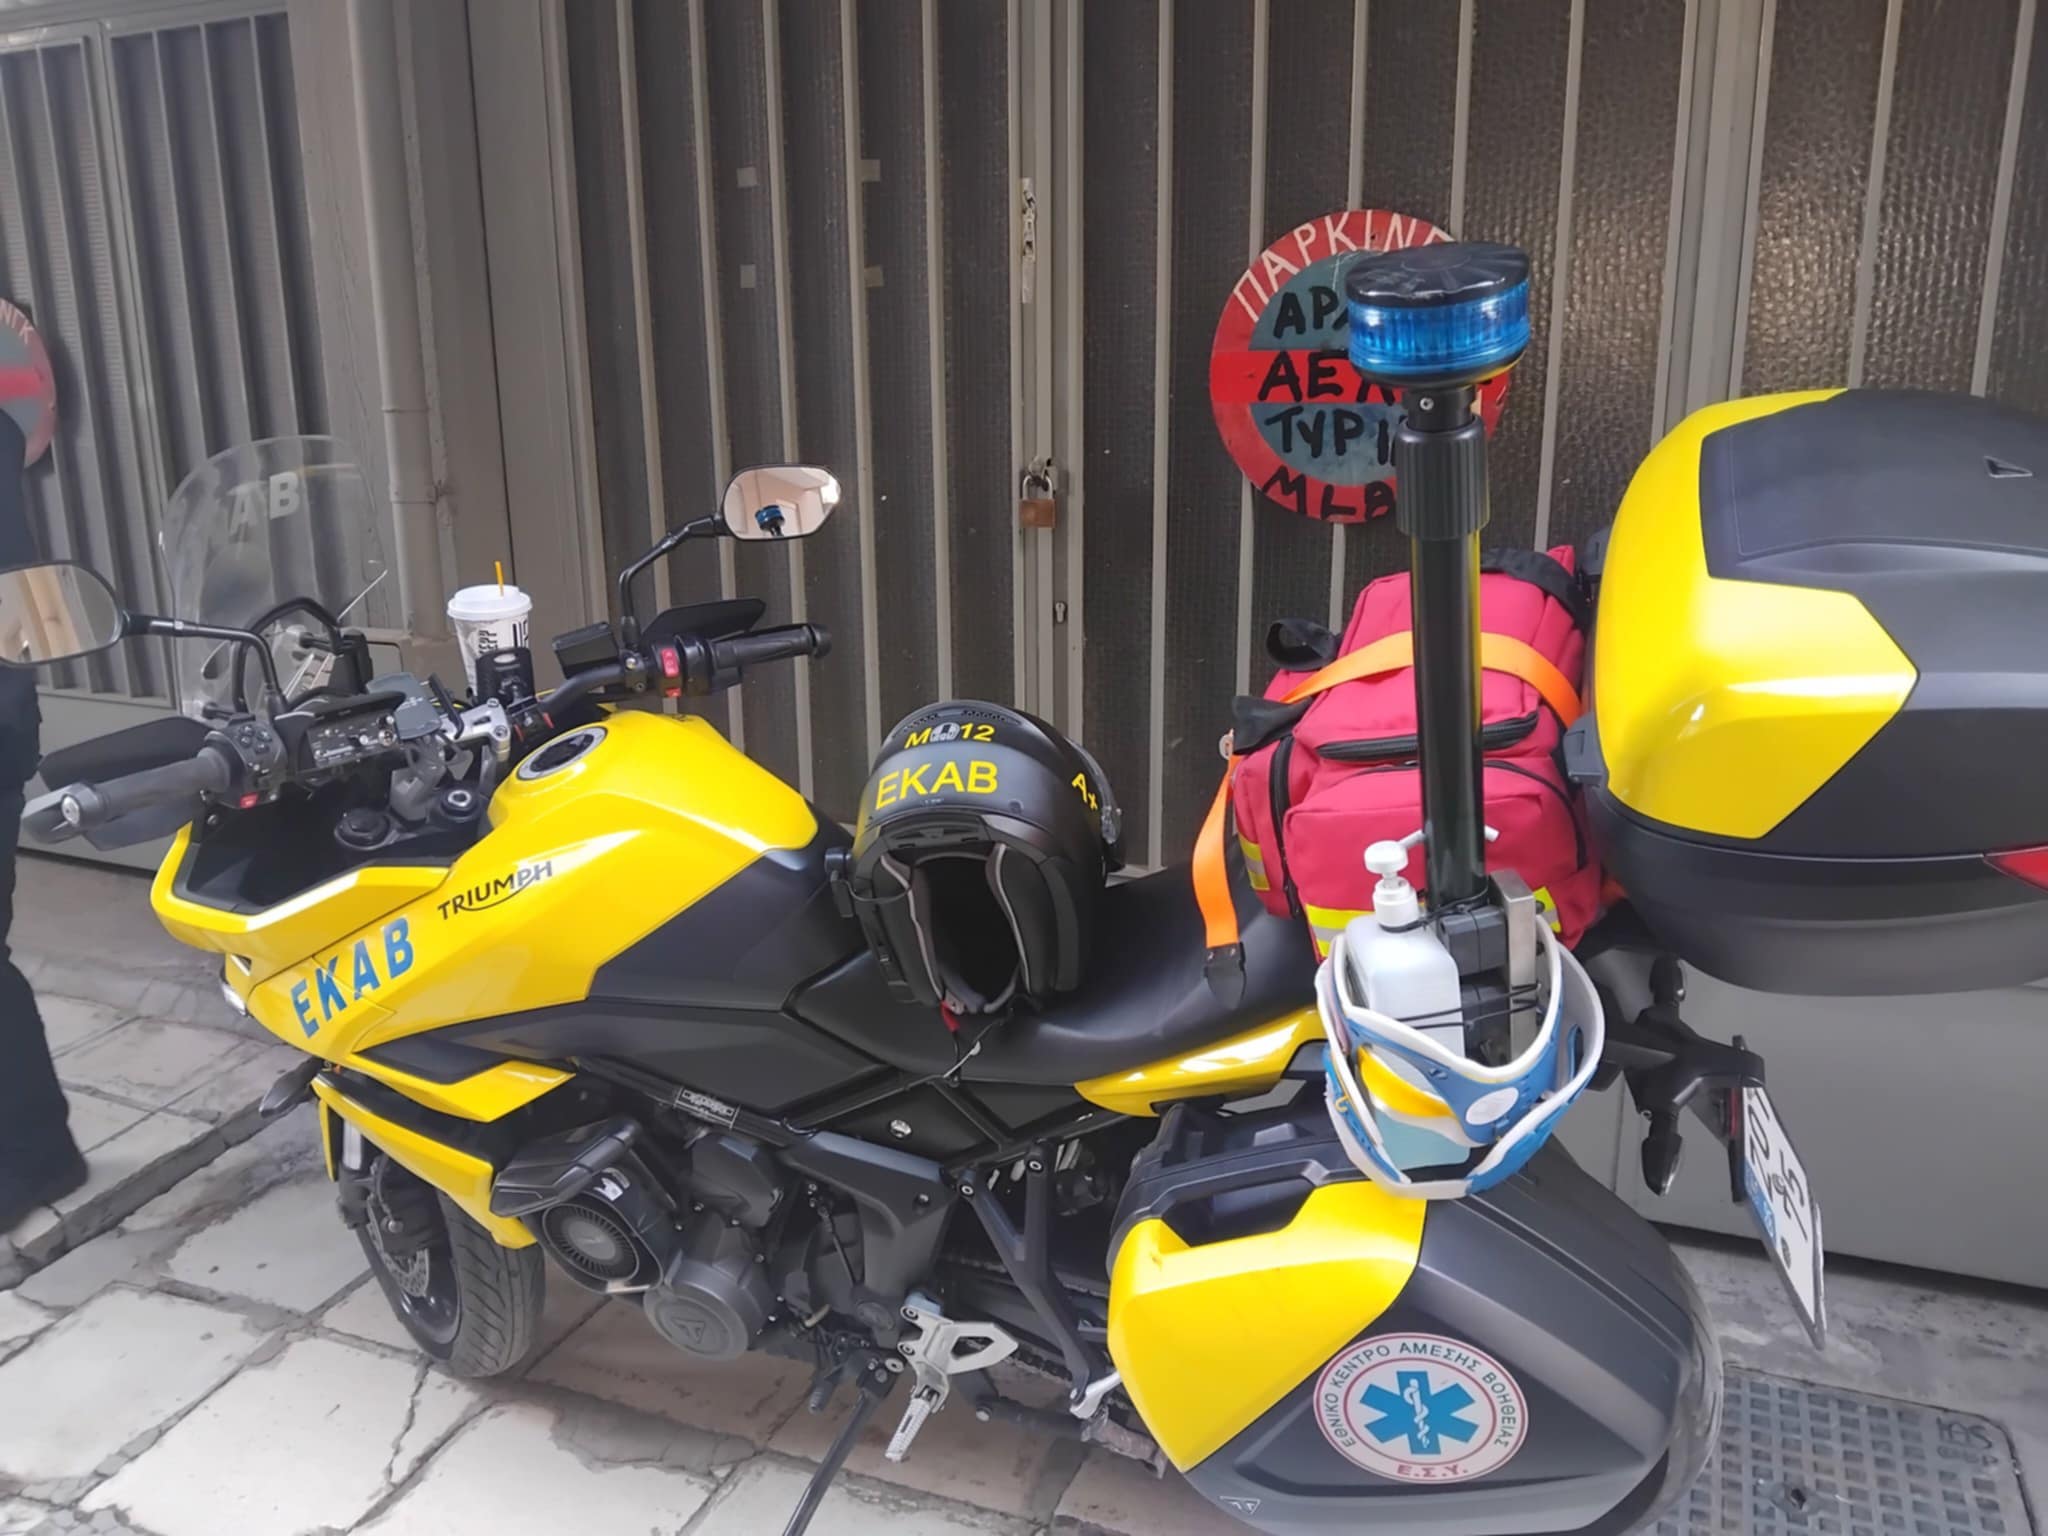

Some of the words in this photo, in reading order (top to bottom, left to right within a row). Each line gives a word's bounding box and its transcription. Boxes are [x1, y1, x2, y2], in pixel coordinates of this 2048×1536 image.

[1273, 285, 1348, 338] ΑΡ
[875, 760, 998, 810] ΕΚΑΒ
[437, 861, 553, 920] TRIUMPH
[290, 916, 415, 1039] ΕΚΑΒ
[1332, 1344, 1390, 1388] ΚΕΝΤΡΟ
[1399, 1342, 1482, 1373] ΑΜΕΣΗΣ
[1325, 1393, 1357, 1447] ΕΘΝΙΚΟ
[1482, 1371, 1517, 1448] ΒΟΗΘΕΙΑΣ
[1396, 1463, 1469, 1478] Ε.Σ.Υ.
